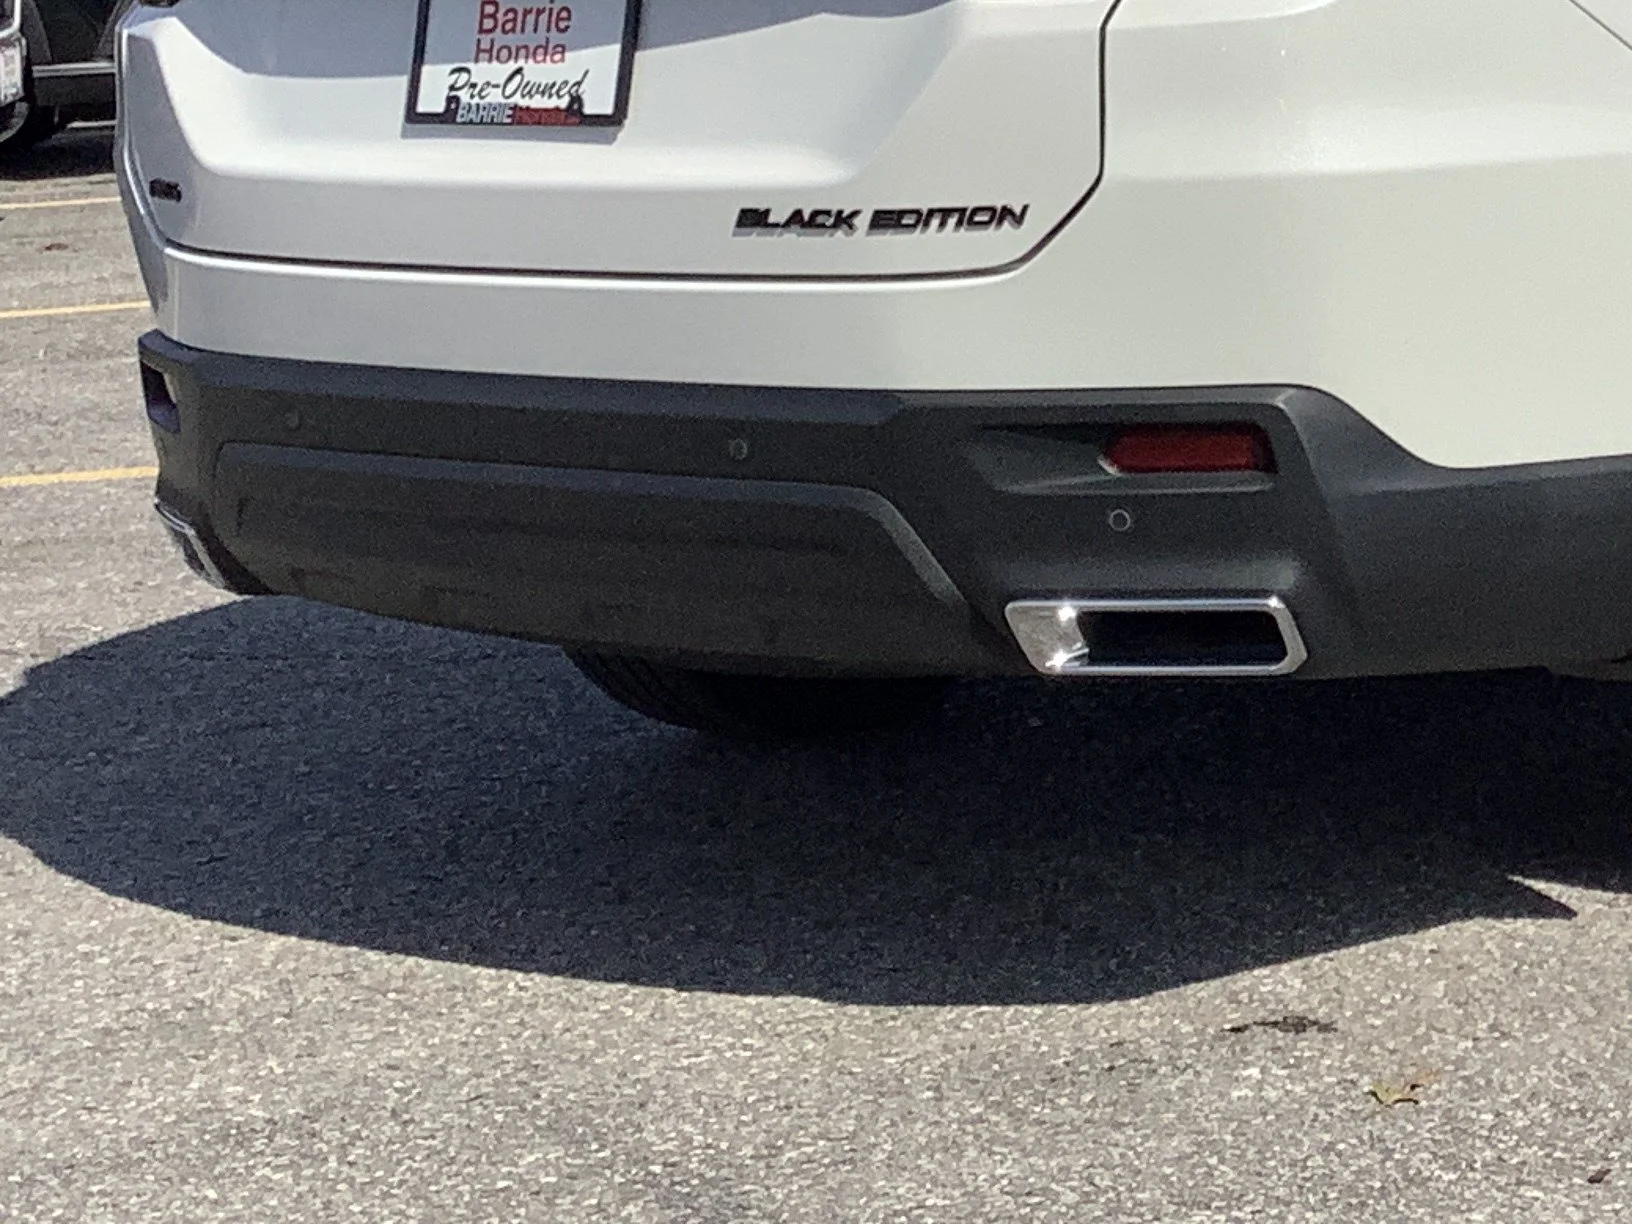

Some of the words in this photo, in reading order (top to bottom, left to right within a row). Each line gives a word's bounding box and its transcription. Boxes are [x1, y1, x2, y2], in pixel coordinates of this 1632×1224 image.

[473, 36, 567, 65] Honda
[447, 66, 590, 102] Pre-Owned
[456, 102, 514, 124] BARRIE
[734, 207, 864, 232] BLACK
[868, 204, 1031, 232] EDITION
